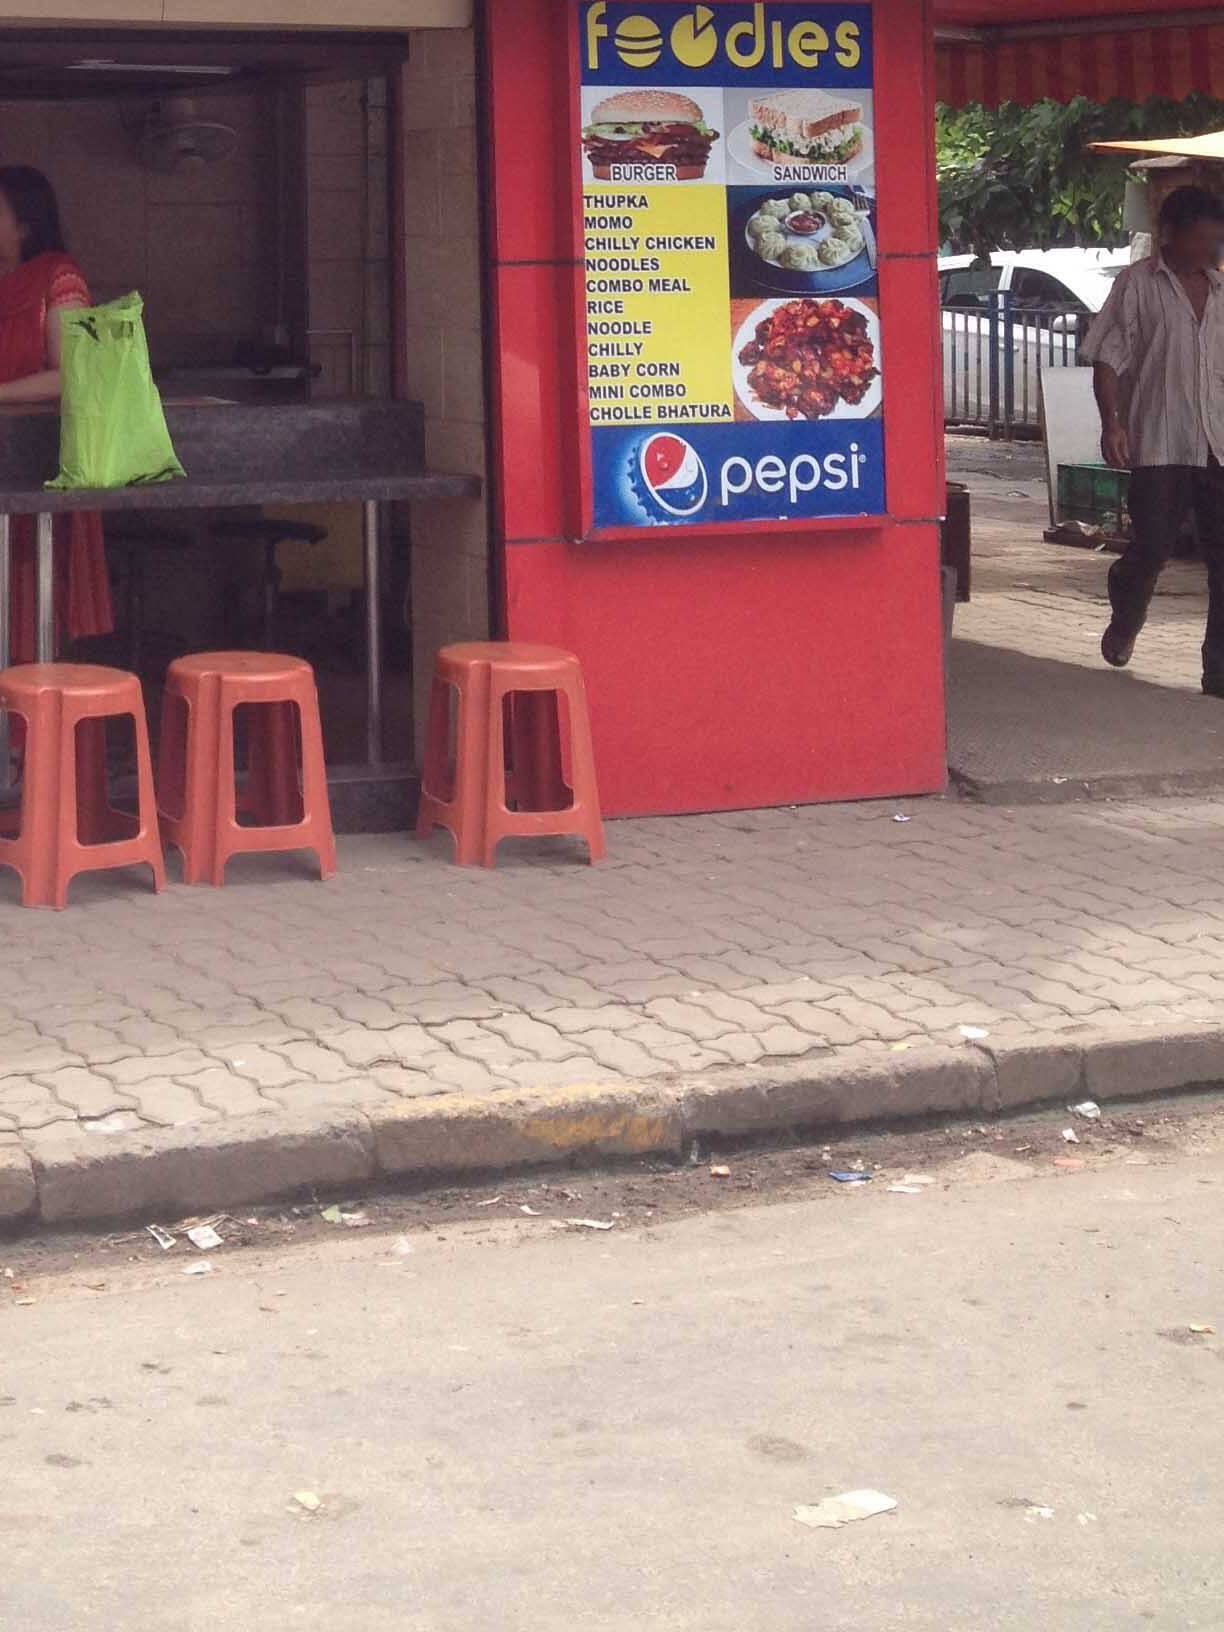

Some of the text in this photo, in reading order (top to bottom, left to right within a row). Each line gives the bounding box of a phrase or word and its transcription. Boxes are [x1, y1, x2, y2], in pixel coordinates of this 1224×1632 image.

[586, 0, 861, 70] foodies
[611, 165, 677, 181] BURGER
[774, 166, 847, 181] SANDWICH
[584, 195, 649, 208] THUPKA
[584, 216, 633, 229] MOMO
[585, 236, 716, 250] CHILLY CHICKEN
[586, 258, 660, 271] NOODLES
[586, 278, 691, 293] COMBO MEAL
[587, 300, 624, 314] RICE
[588, 321, 652, 335] NOODLE
[588, 342, 643, 356] CHILLY
[589, 363, 680, 378] BABY CORN
[589, 384, 686, 399] MINI COMBO
[590, 404, 732, 421] CHOLLE BHATURA
[720, 442, 859, 506] pepsi
